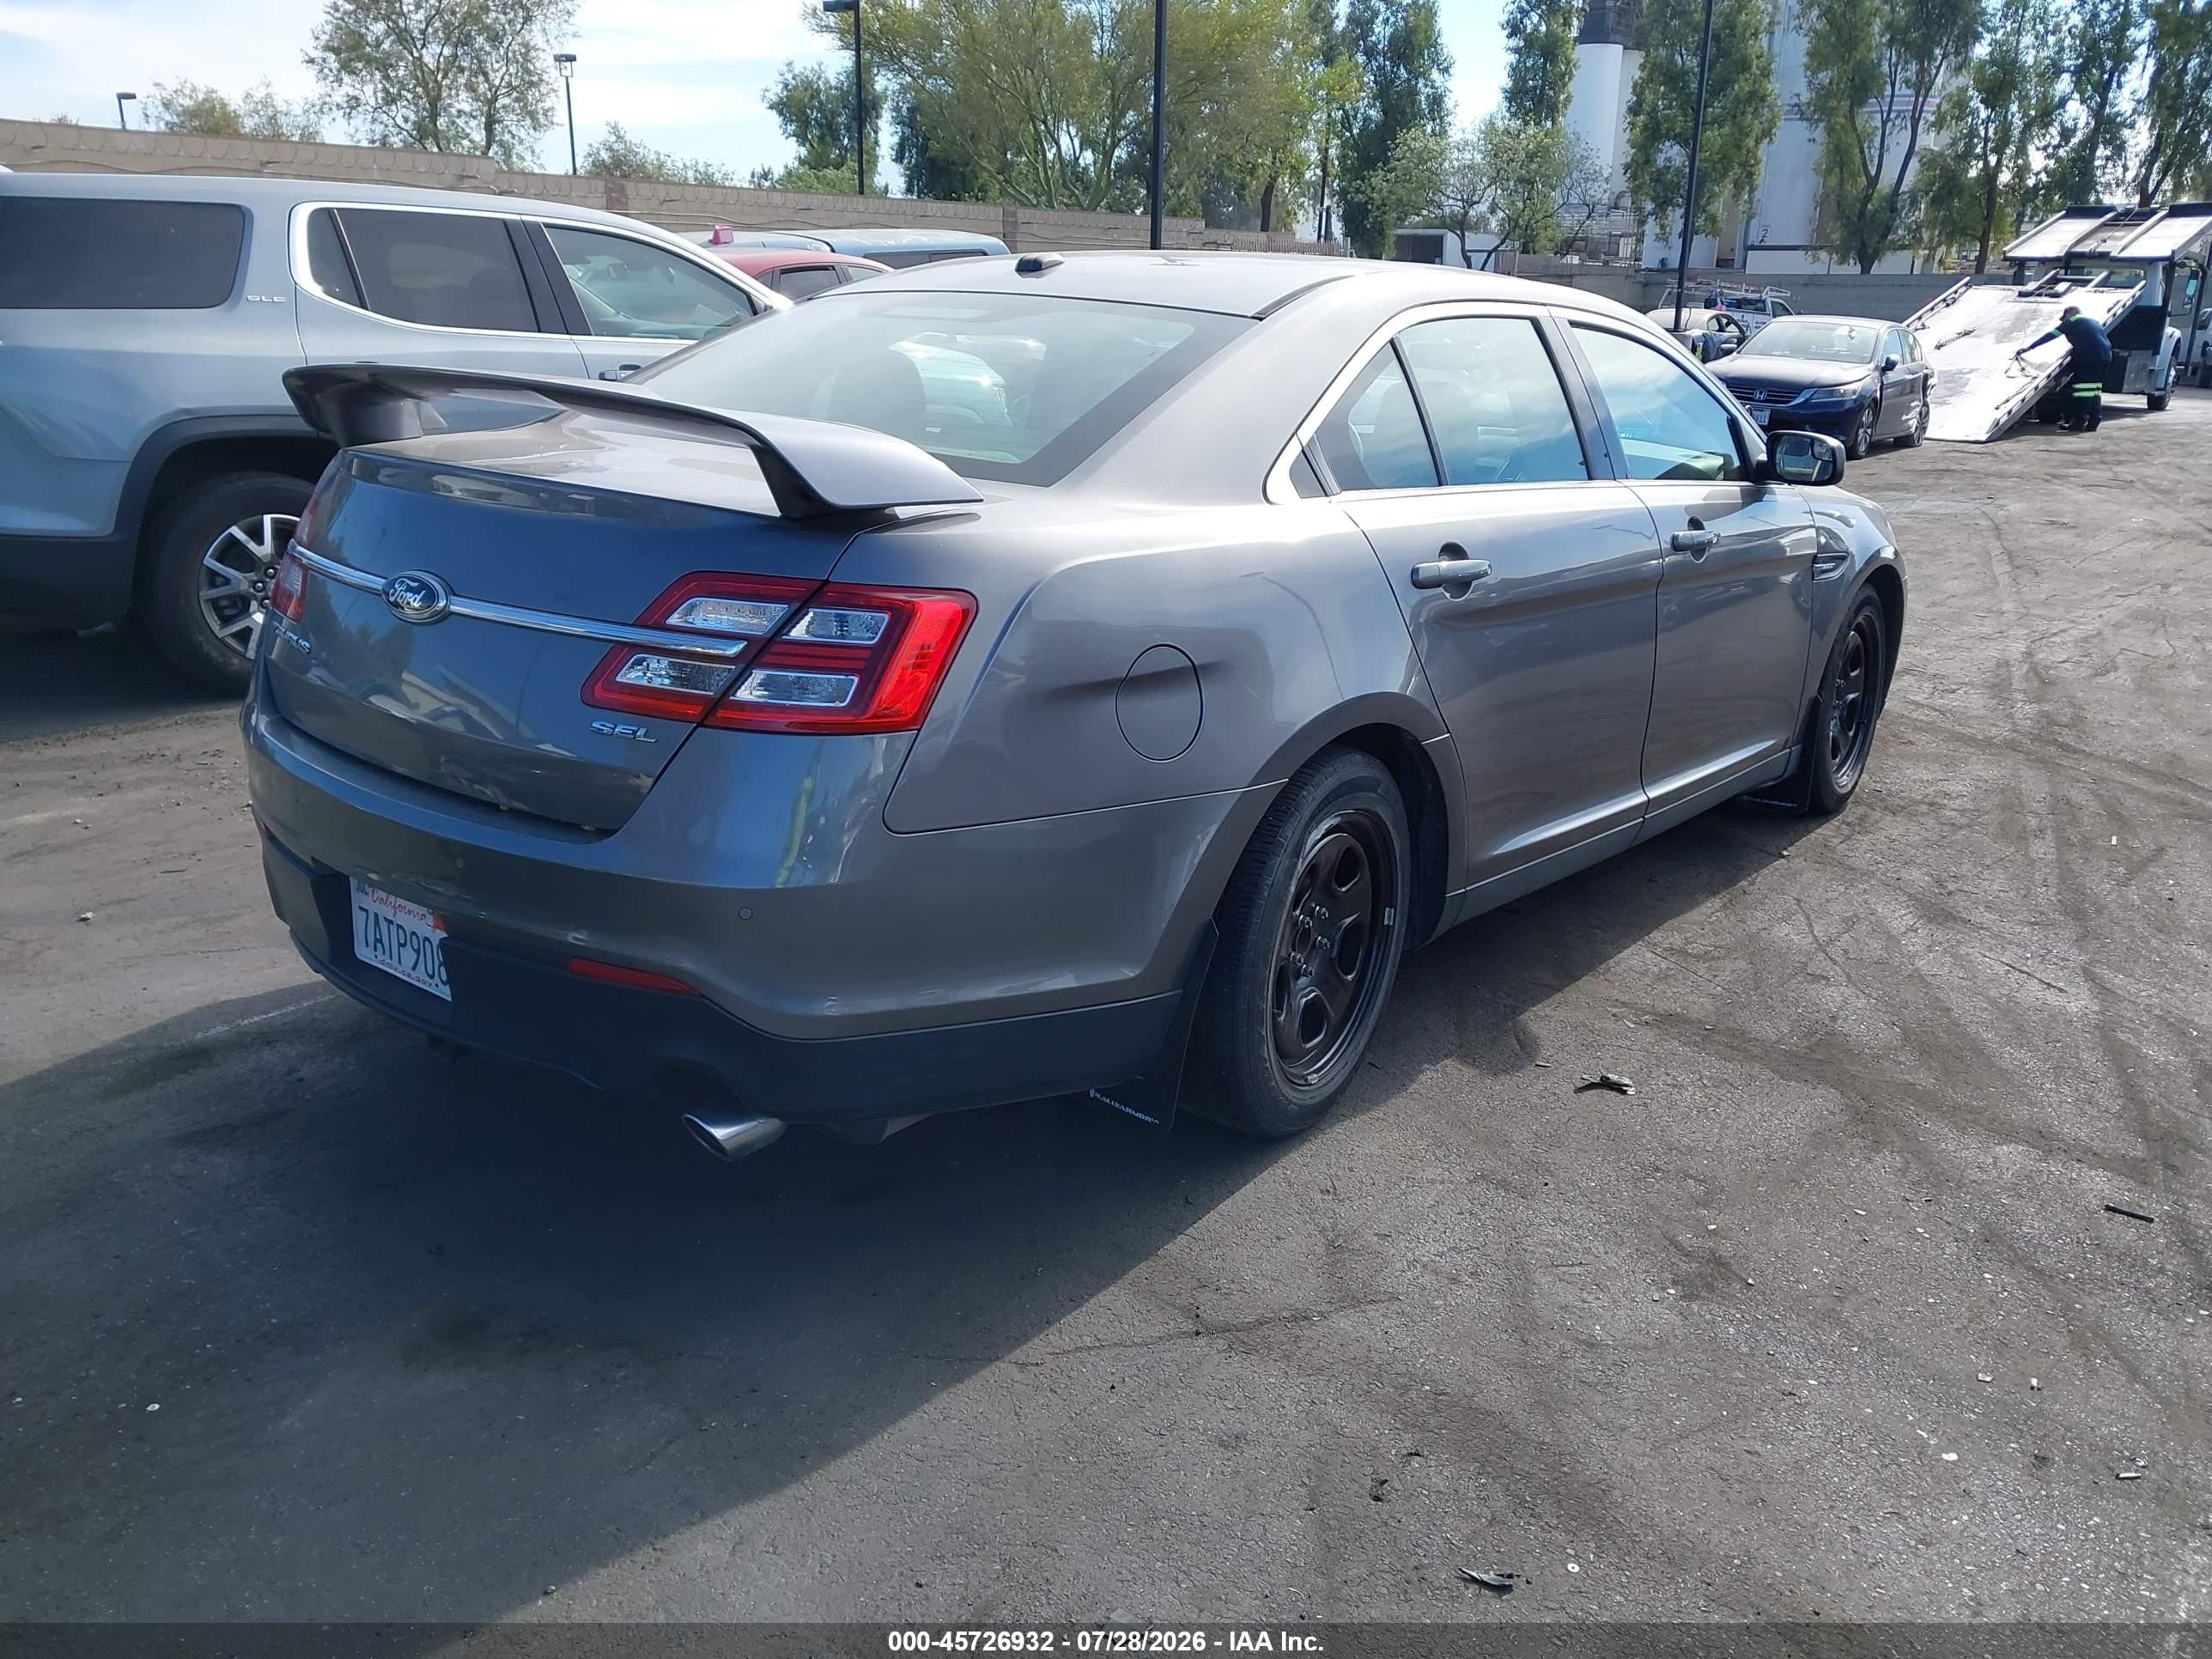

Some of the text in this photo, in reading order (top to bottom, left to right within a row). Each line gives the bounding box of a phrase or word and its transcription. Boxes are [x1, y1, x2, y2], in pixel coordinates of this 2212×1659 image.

[388, 577, 426, 608] Ford
[589, 720, 659, 743] SEL
[370, 885, 429, 922] California
[358, 904, 449, 987] 7ATP908
